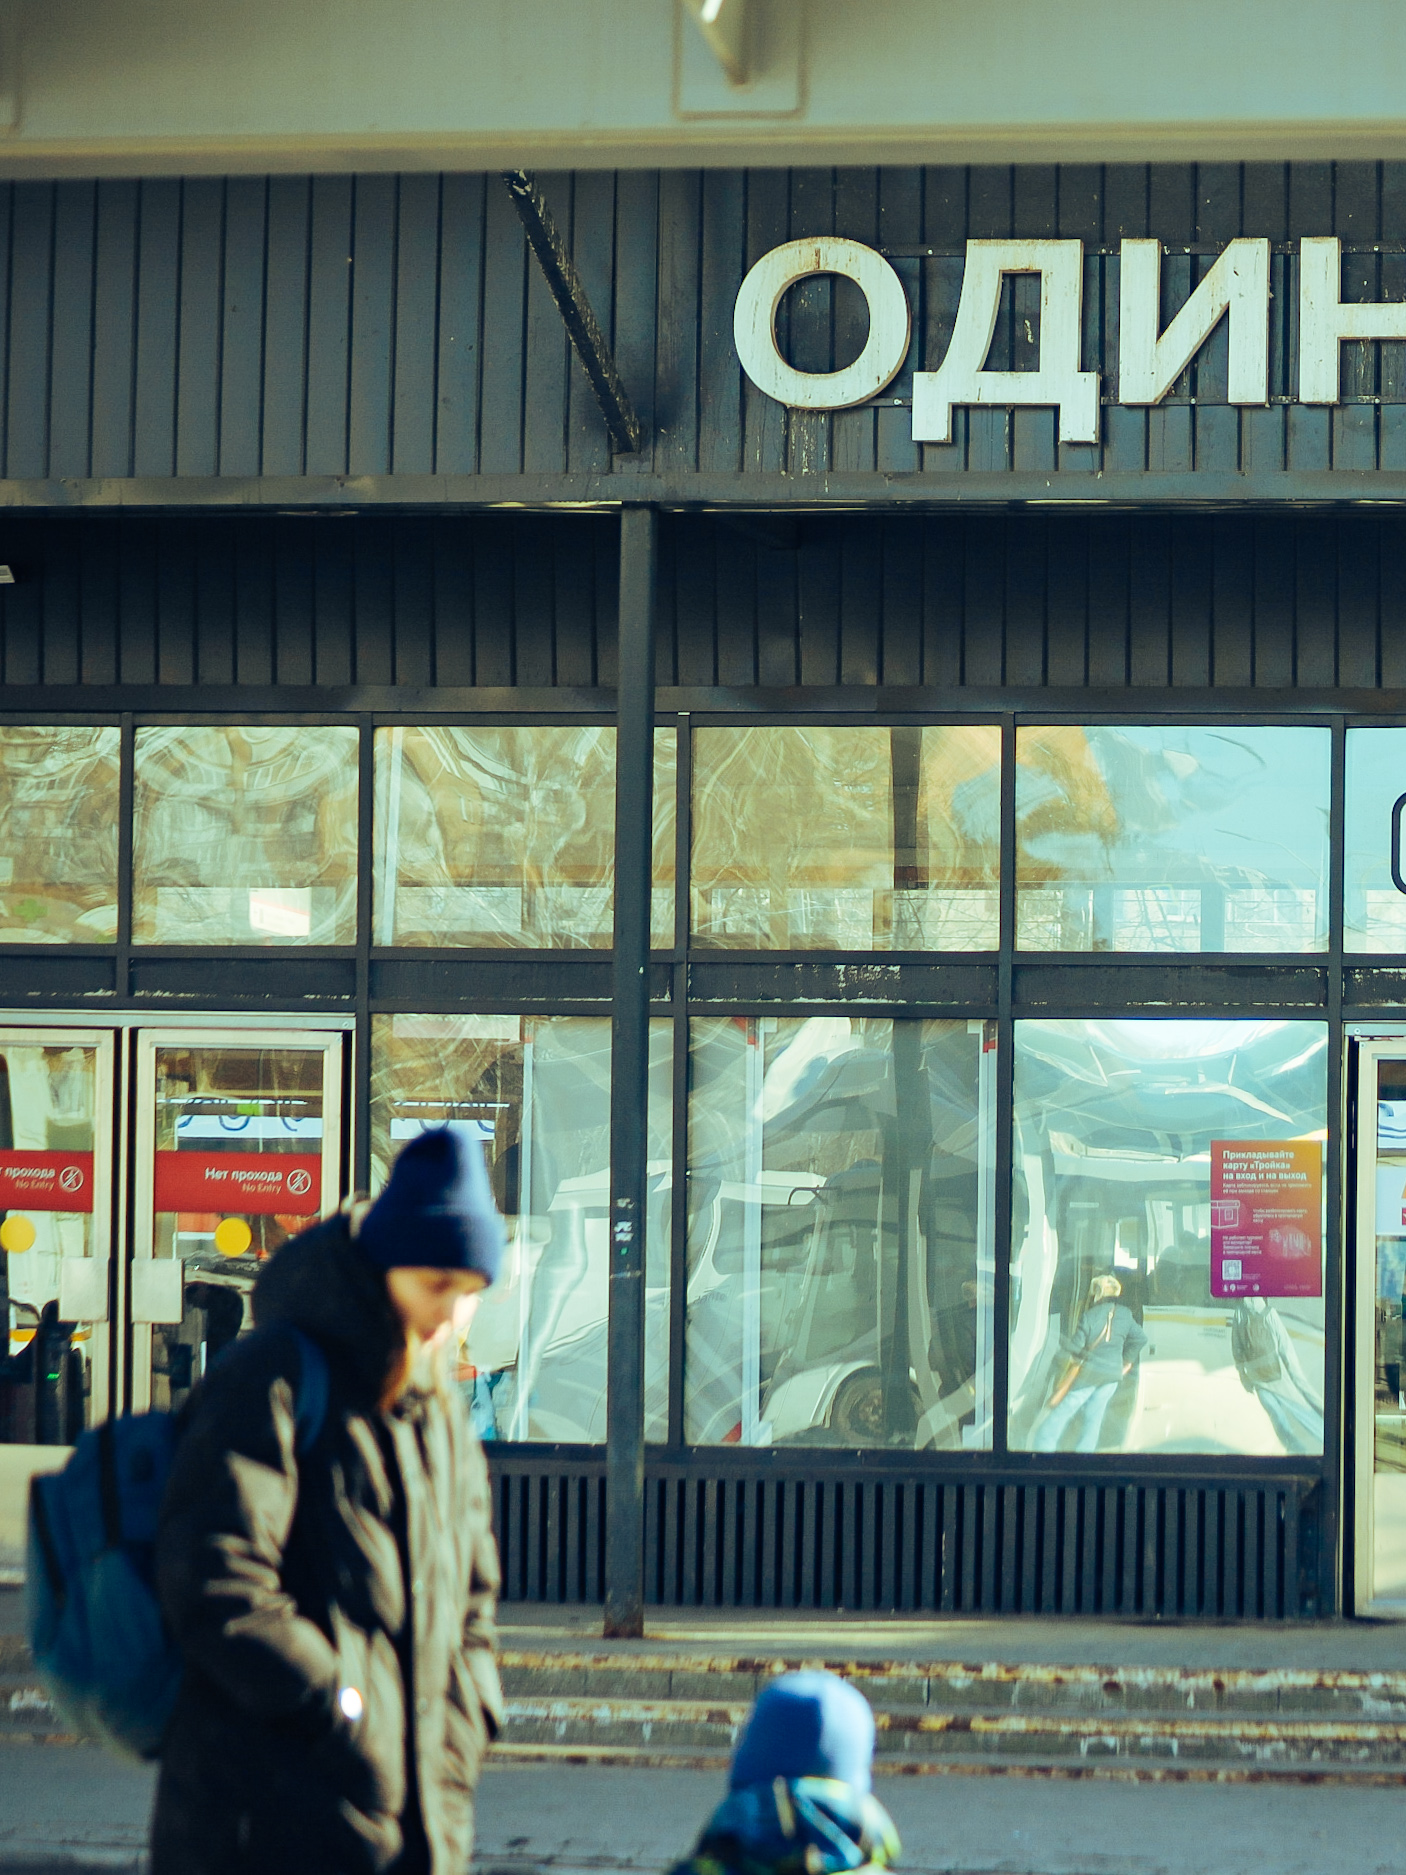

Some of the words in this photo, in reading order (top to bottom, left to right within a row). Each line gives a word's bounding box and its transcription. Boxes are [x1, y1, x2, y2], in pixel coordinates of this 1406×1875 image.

[1222, 1150, 1295, 1161] Прикладывайте
[1222, 1162, 1248, 1171] карту
[4, 1167, 56, 1180] прохода
[204, 1167, 230, 1181] Нет
[231, 1169, 283, 1184] прохода
[1222, 1173, 1235, 1181] на
[1235, 1172, 1257, 1181] вход
[1258, 1172, 1265, 1181] и
[1265, 1173, 1278, 1181] на
[1278, 1172, 1308, 1181] выход
[15, 1180, 30, 1189] No
[30, 1180, 55, 1192] Entry
[242, 1183, 256, 1193] No
[257, 1183, 282, 1195] Entry
